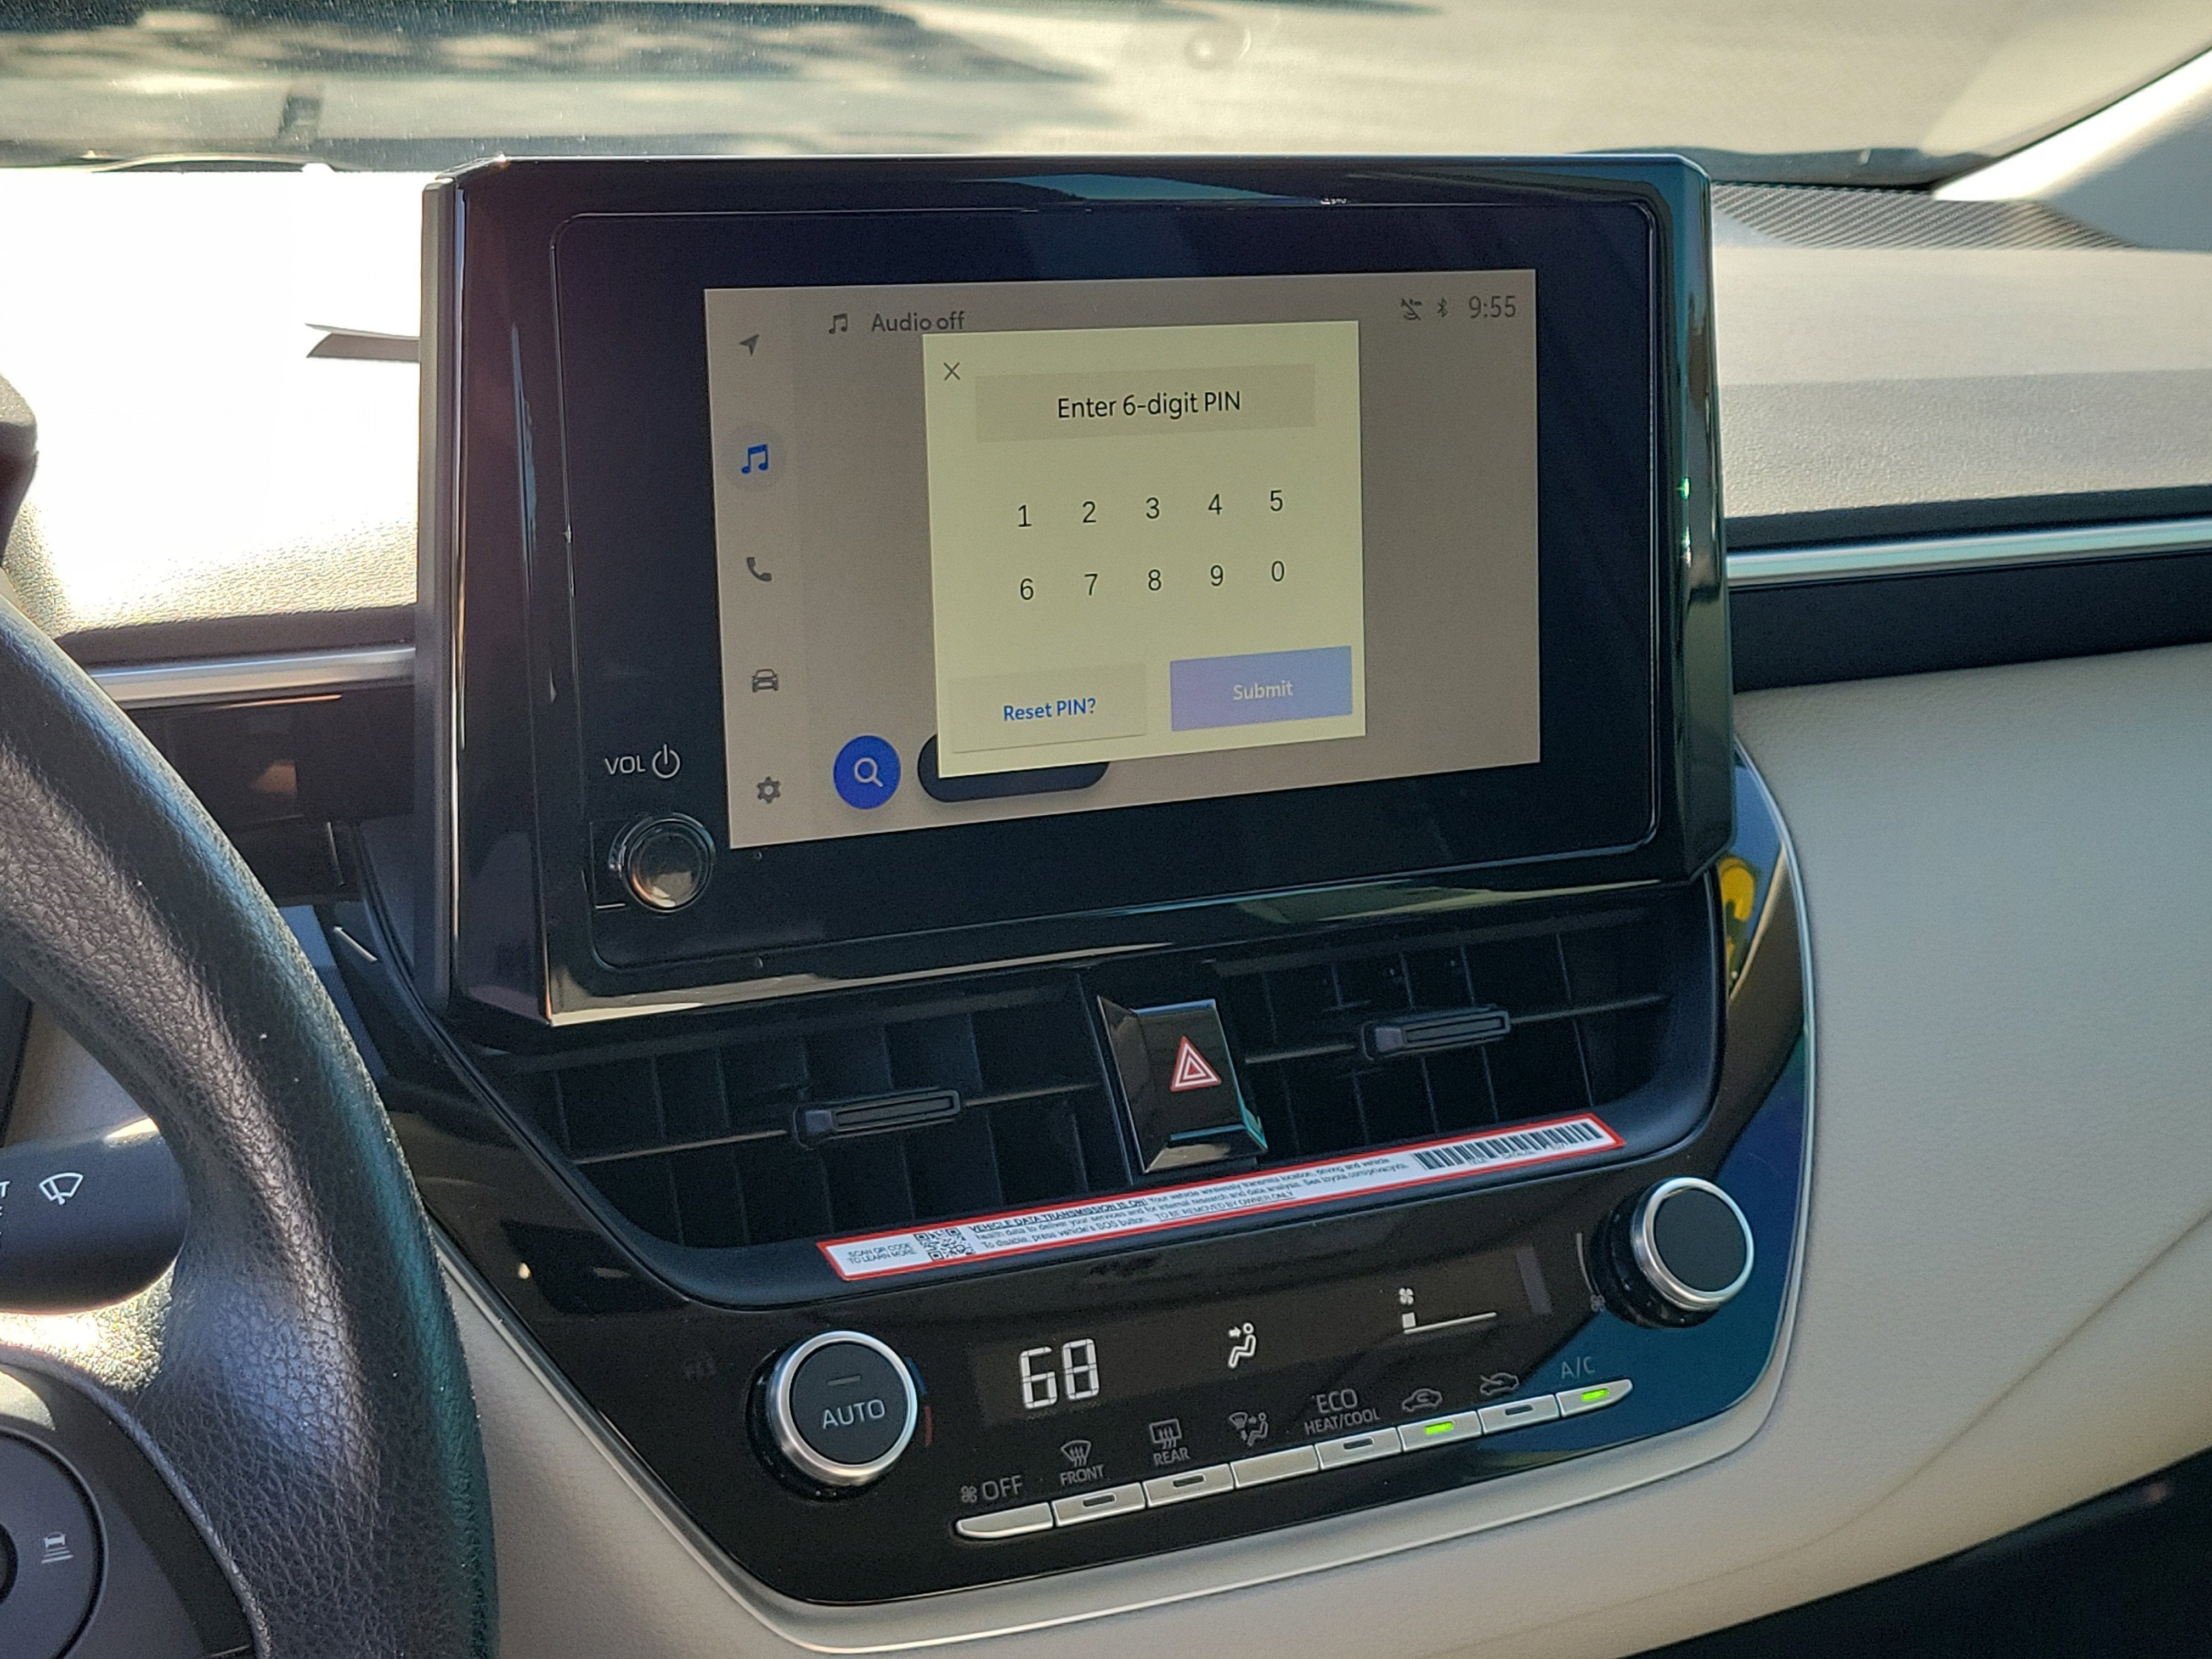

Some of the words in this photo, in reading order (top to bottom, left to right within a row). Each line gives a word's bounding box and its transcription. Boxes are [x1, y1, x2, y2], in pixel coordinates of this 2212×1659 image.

[1468, 295, 1517, 319] 9:55
[871, 312, 932, 332] Audio
[936, 311, 966, 330] off
[1058, 396, 1117, 419] Enter
[1122, 392, 1199, 420] 6-digit
[1204, 390, 1242, 412] PIN
[1017, 504, 1032, 528] 1
[1082, 500, 1097, 524] 2
[1145, 496, 1161, 520] 3
[1208, 493, 1223, 516] 4
[1269, 489, 1284, 512] 5
[1019, 577, 1035, 600] 6
[1084, 573, 1098, 596] 7
[1147, 568, 1162, 591] 8
[1210, 564, 1224, 587] 9
[1271, 560, 1285, 583] 0
[1232, 679, 1294, 701] Submit
[1003, 702, 1052, 721] Reset
[1056, 697, 1097, 717] PIN?
[604, 754, 646, 775] VOL
[969, 1220, 1015, 1232] VEHICLE
[1013, 1216, 1041, 1225] DATA
[1042, 1203, 1117, 1221] TRANSMISSION
[1018, 1338, 1100, 1409] 68
[1561, 1356, 1596, 1379] A/C
[822, 1398, 886, 1429] AUTO
[1316, 1387, 1359, 1414] ECO
[1304, 1408, 1381, 1435] HEAT/COOL
[1154, 1446, 1190, 1466] REAR
[981, 1474, 1024, 1501] OFF
[1060, 1464, 1104, 1486] FRONT
